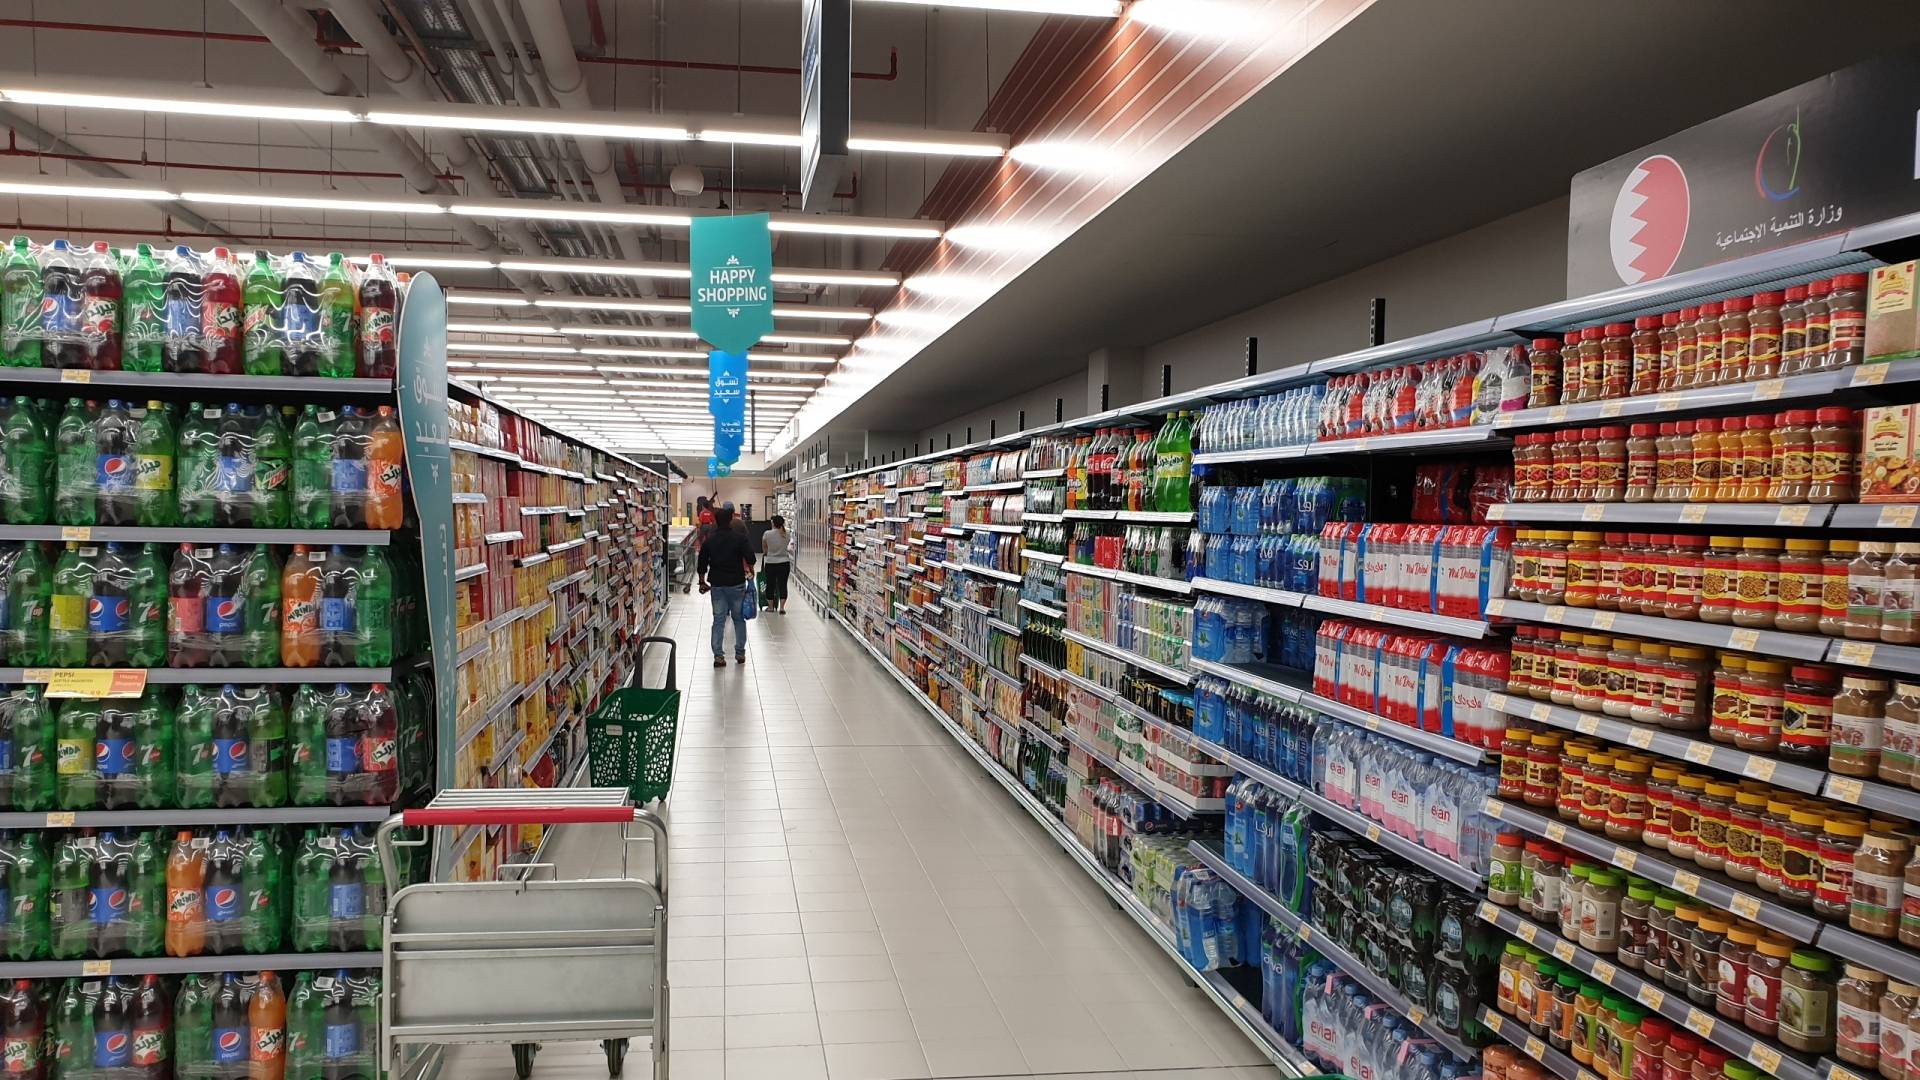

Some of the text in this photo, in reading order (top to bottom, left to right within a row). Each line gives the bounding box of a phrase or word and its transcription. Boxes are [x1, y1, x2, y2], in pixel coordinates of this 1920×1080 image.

[1770, 211, 1804, 237] التنمية
[1808, 204, 1843, 228] وزارة
[710, 268, 756, 285] HAPPY
[697, 286, 767, 302] SHOPPING
[715, 377, 739, 387] تسوق
[713, 388, 740, 397] سعيد
[136, 459, 160, 475] ميرند
[380, 463, 401, 482] يرندا
[372, 741, 396, 761] يرندا
[1330, 762, 1346, 776] eian
[1365, 774, 1381, 789] eian
[1391, 790, 1409, 804] eian
[1431, 805, 1450, 821] eian
[1310, 1020, 1337, 1043] evian
[1350, 1056, 1374, 1080] eian
